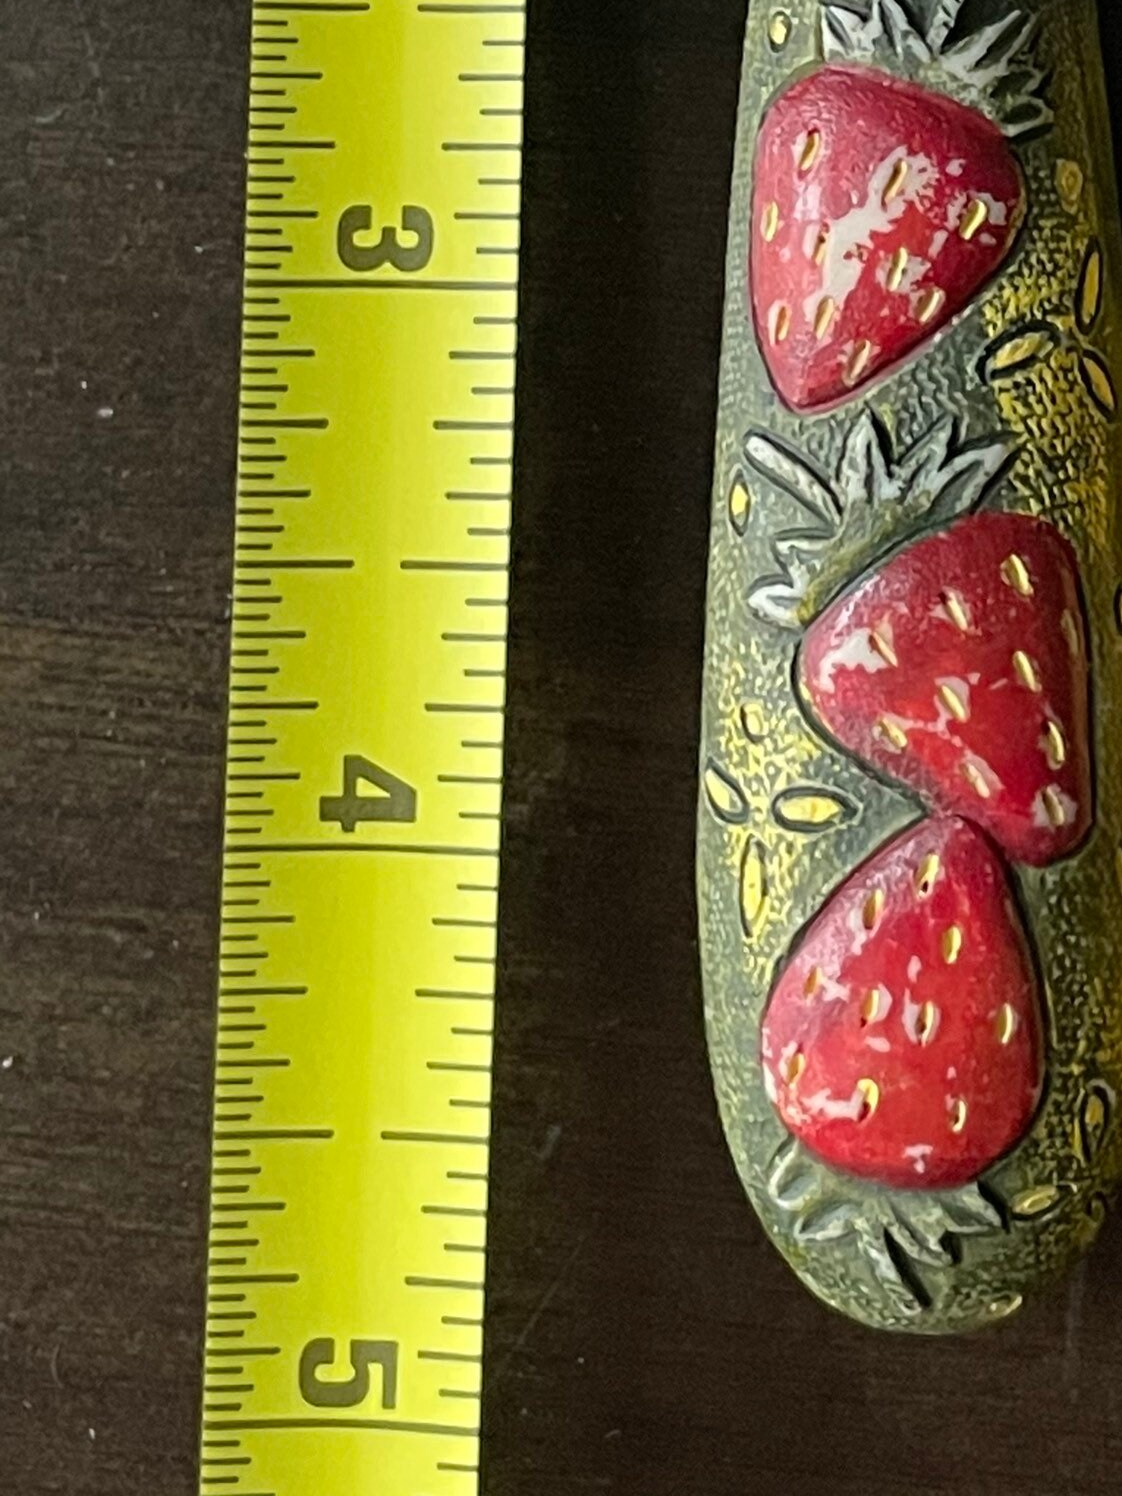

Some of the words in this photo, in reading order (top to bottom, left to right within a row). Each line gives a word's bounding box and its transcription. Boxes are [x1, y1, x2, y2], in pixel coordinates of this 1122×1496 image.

[337, 205, 433, 273] 3
[319, 754, 418, 834] 4
[298, 1337, 399, 1409] 5
